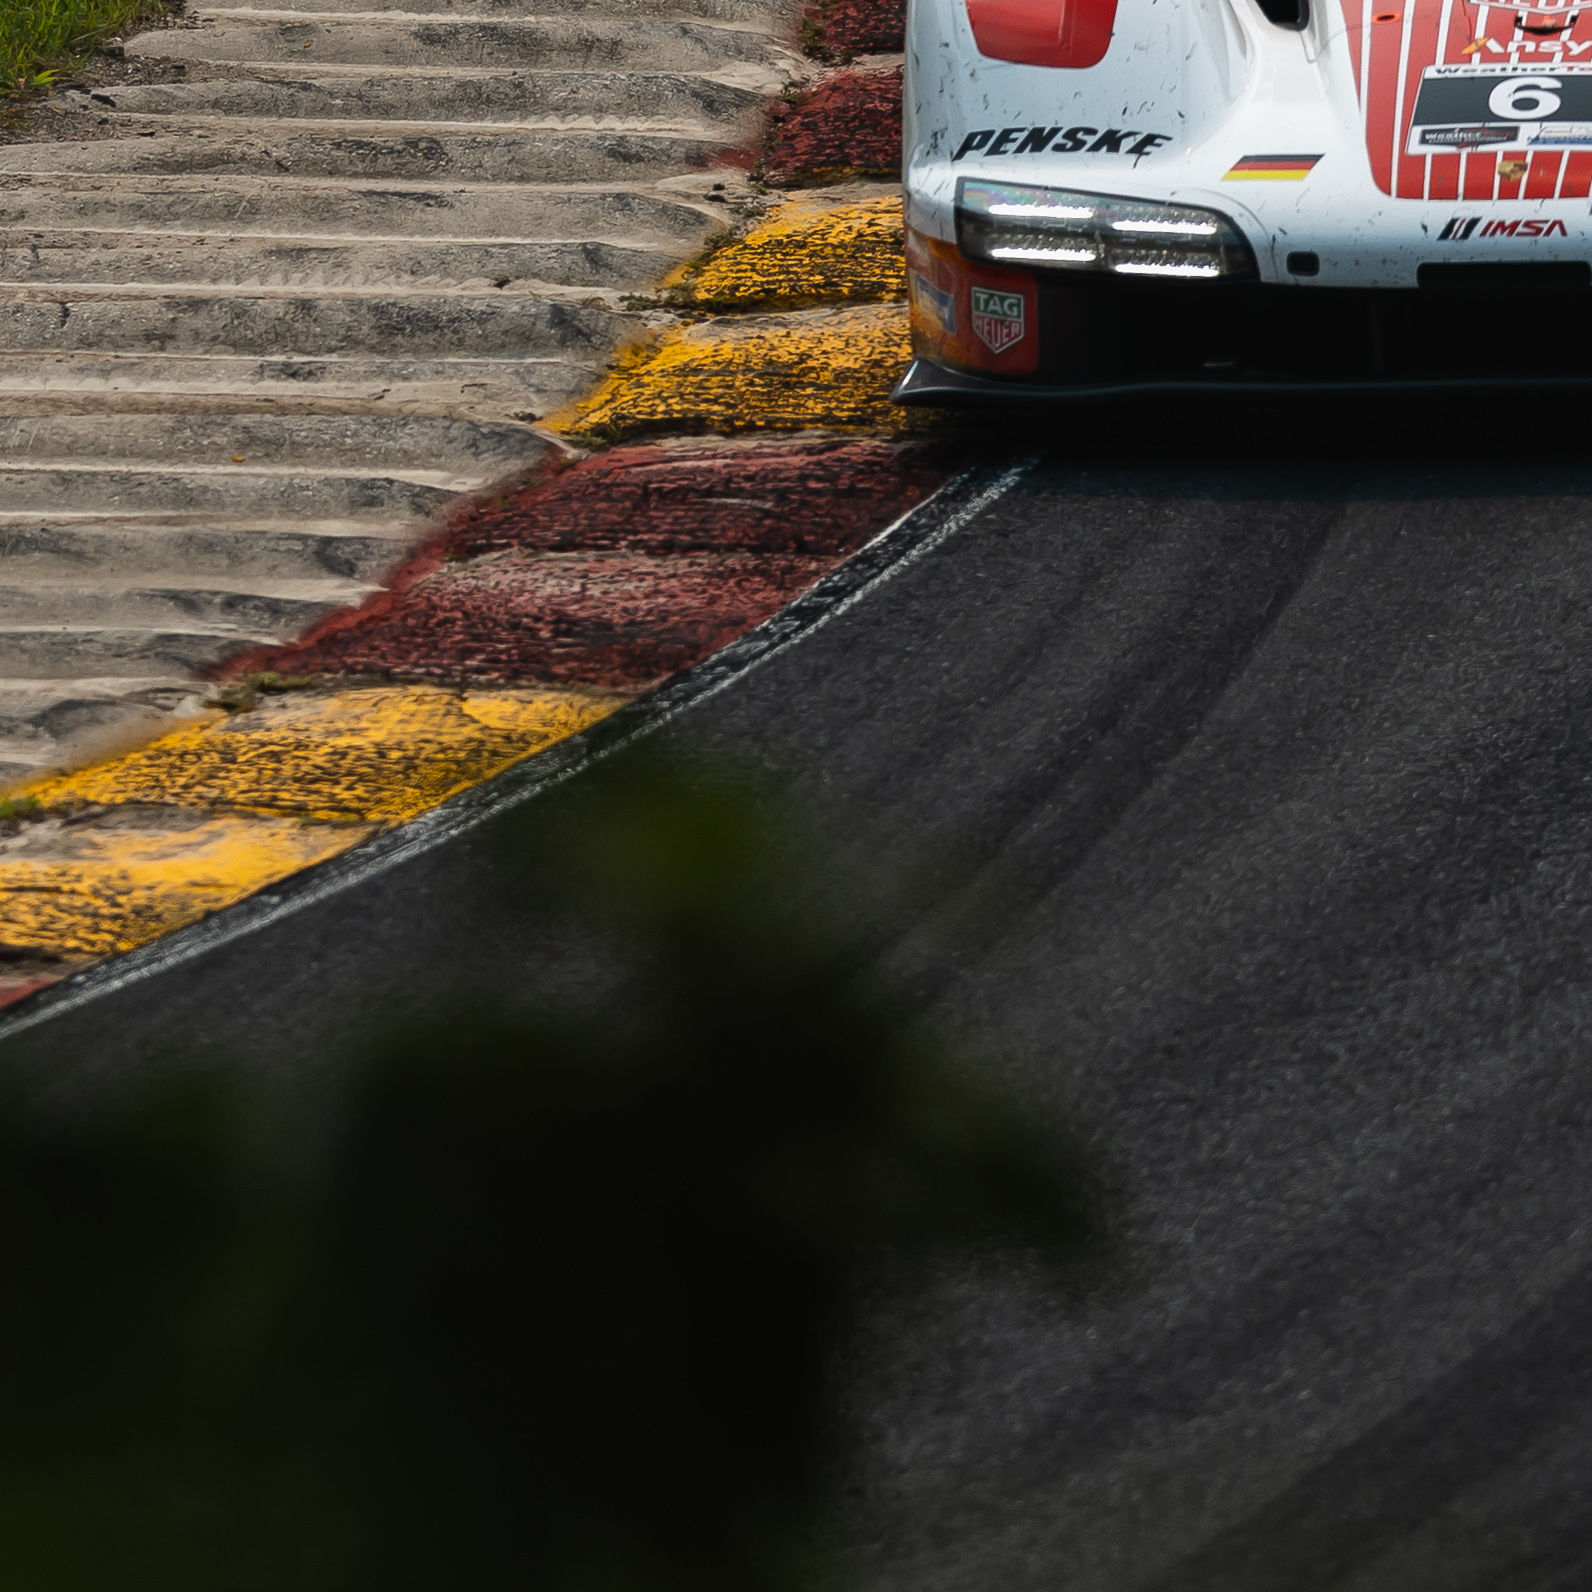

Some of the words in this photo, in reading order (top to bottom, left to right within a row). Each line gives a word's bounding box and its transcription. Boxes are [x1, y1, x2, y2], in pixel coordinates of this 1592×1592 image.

[1488, 76, 1563, 120] 6
[951, 126, 1173, 163] PENSKE
[1479, 218, 1568, 238] IMSA
[975, 292, 1019, 317] TAG
[973, 315, 1021, 348] HEUER
